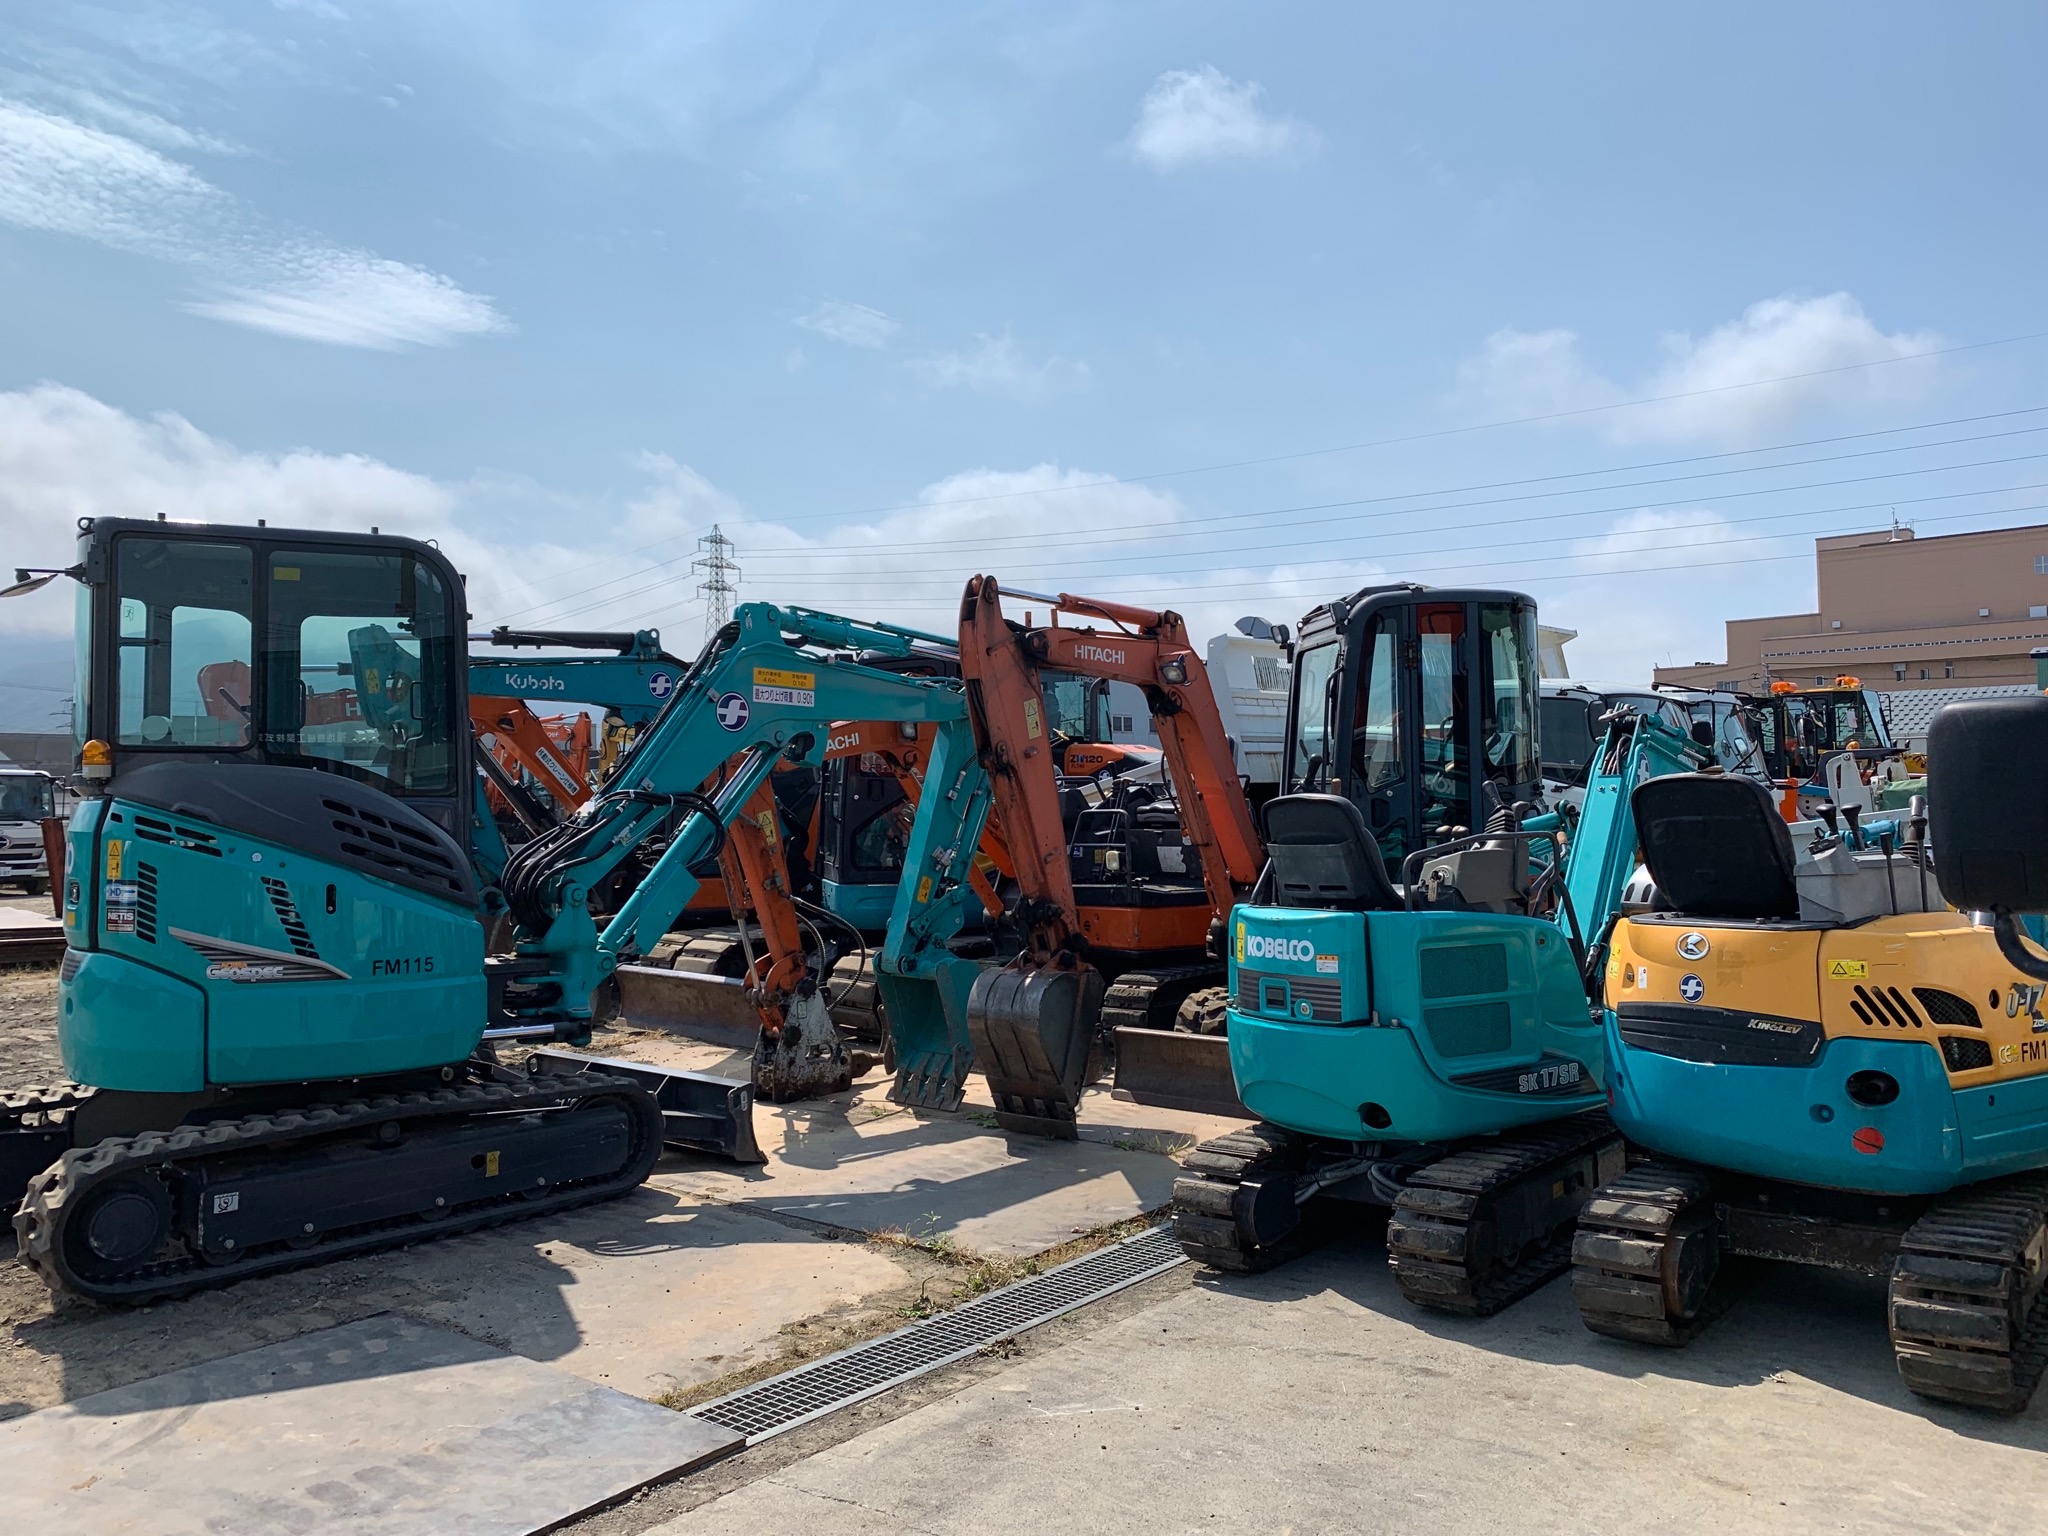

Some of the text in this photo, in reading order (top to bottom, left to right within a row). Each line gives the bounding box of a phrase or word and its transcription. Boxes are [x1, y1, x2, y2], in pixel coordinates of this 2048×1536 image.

[1074, 644, 1125, 665] HITACHI
[505, 673, 565, 690] Kubota
[797, 692, 813, 704] 0.90t
[108, 912, 134, 920] NETIS
[1247, 935, 1315, 962] KOBELCO
[372, 956, 434, 976] FM115
[2006, 984, 2047, 1018] U-17
[1748, 1018, 1802, 1034] KINGLEV
[1518, 1062, 1580, 1093] SK 17SR
